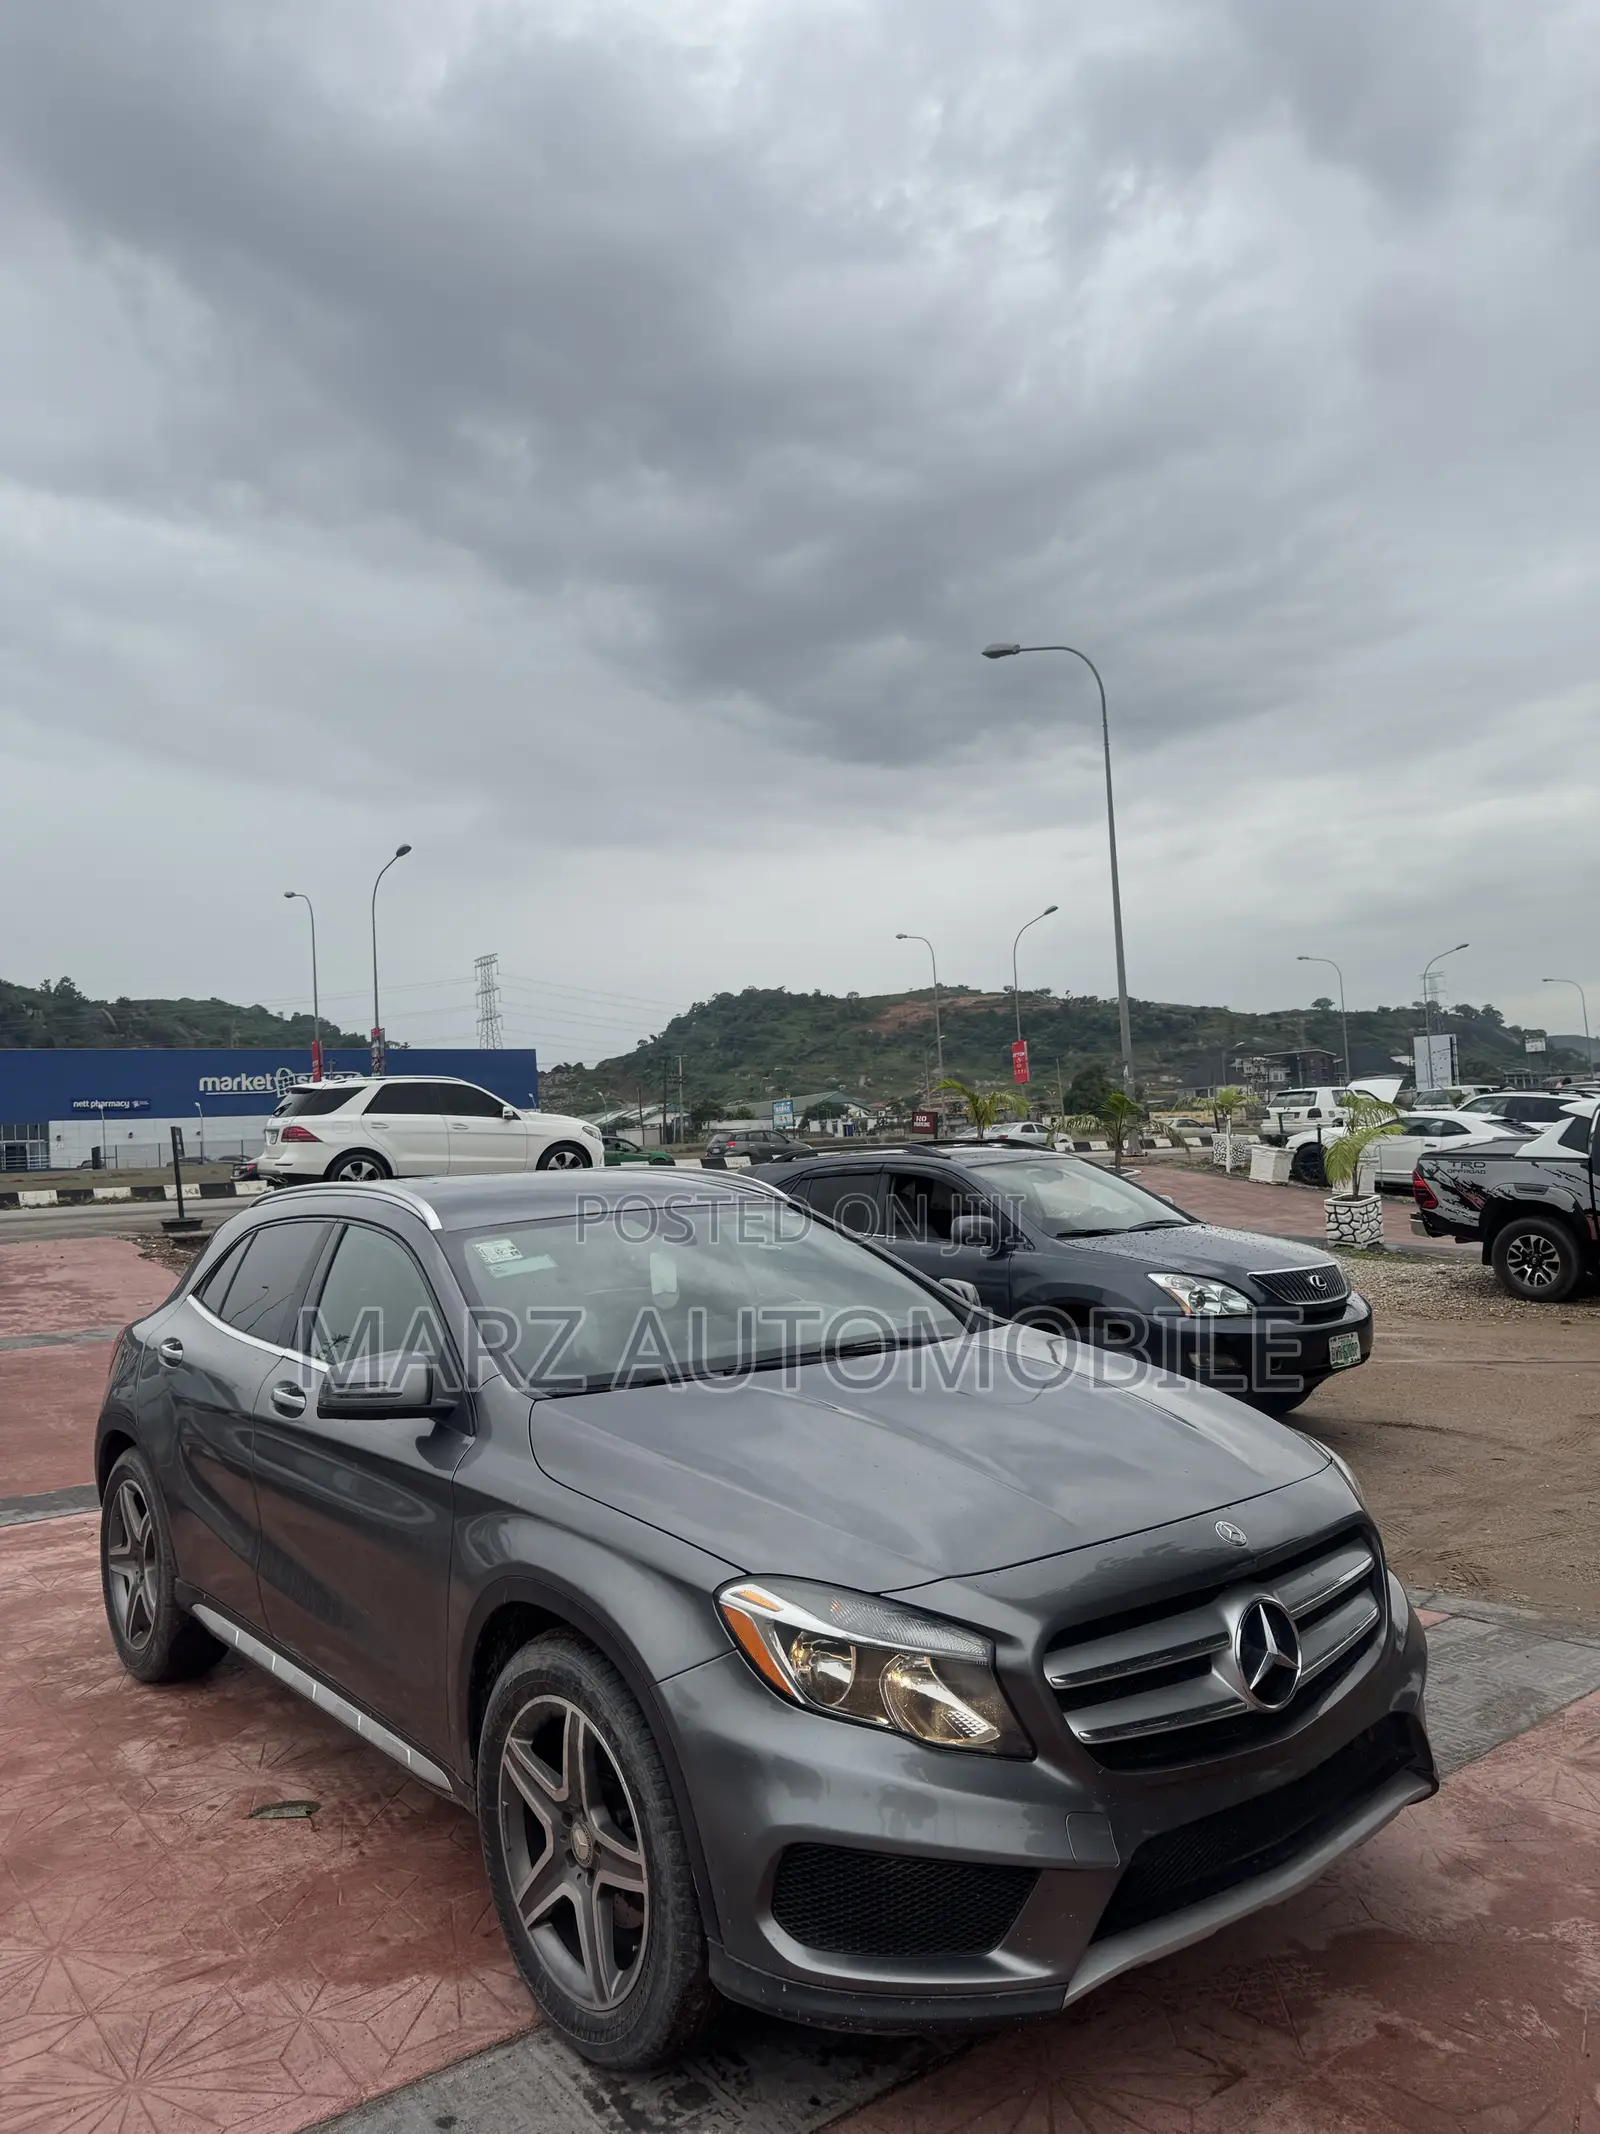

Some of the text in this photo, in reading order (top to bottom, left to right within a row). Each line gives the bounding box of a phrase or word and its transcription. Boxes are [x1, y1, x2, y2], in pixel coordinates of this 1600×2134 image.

[199, 1073, 272, 1092] market
[90, 1100, 130, 1108] pharmacy
[1447, 1161, 1486, 1169] TRD
